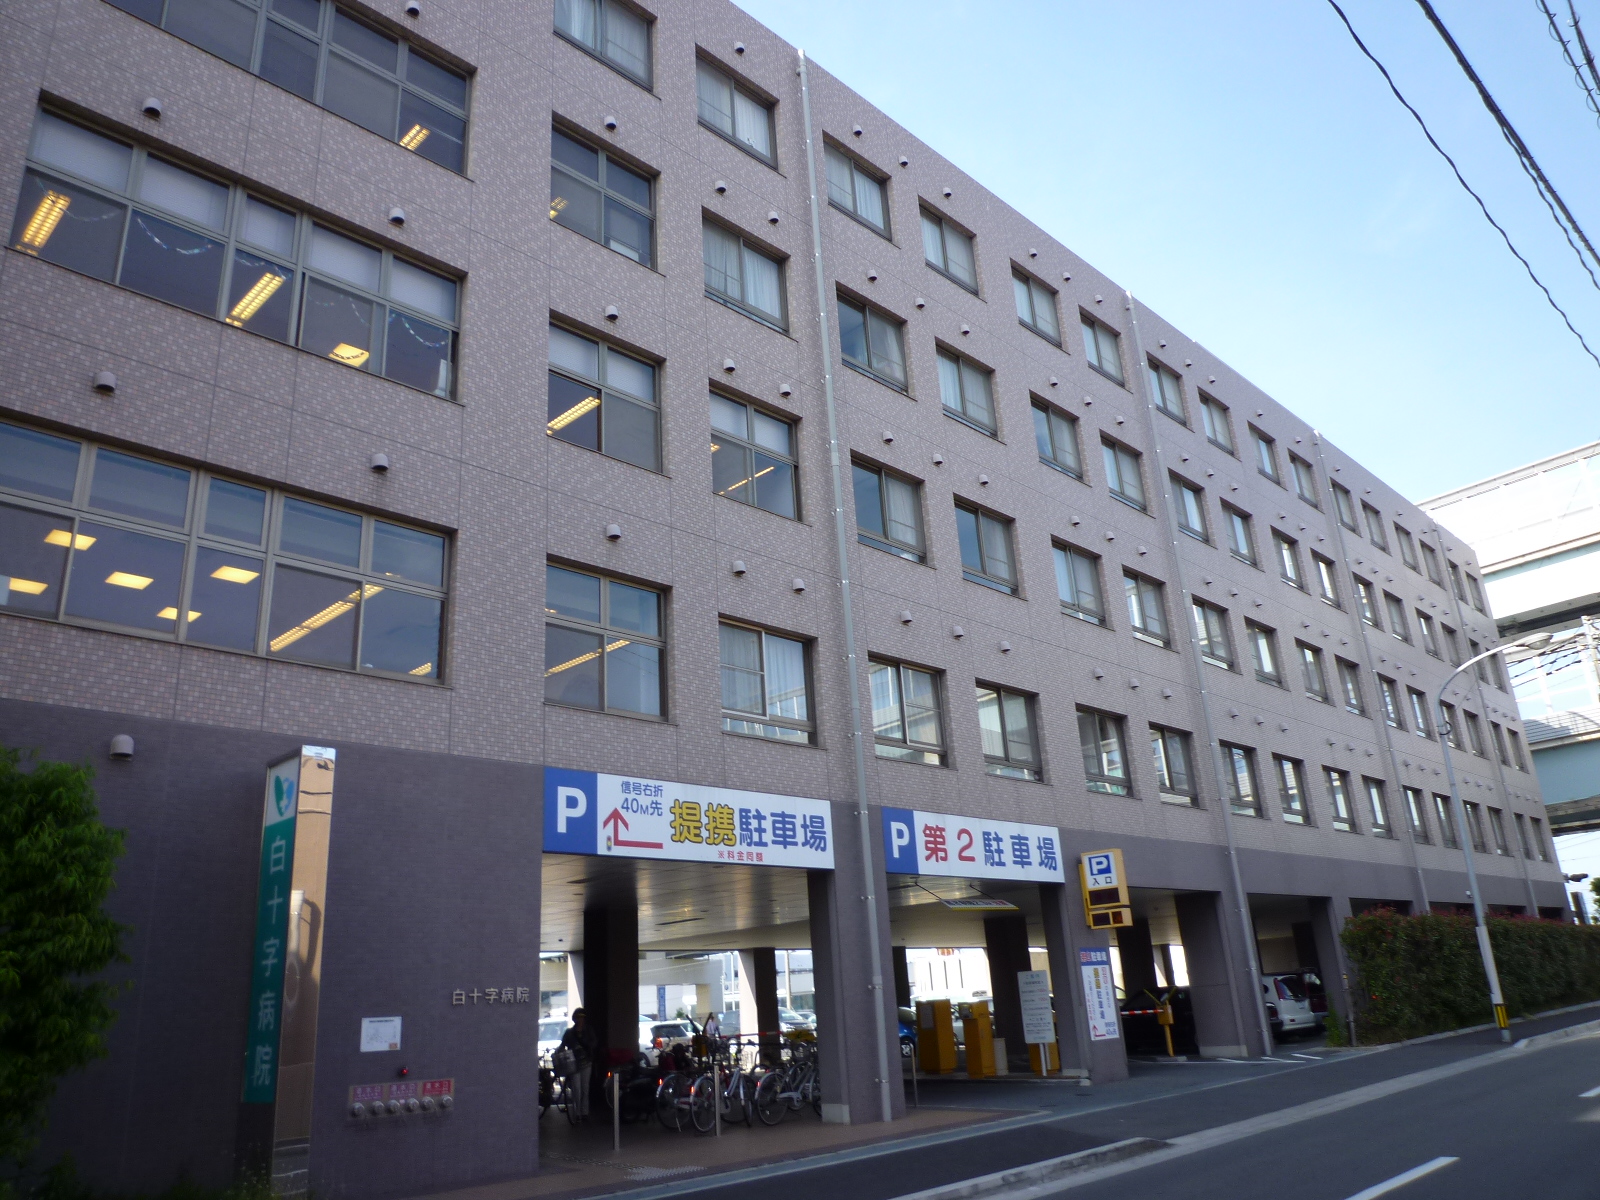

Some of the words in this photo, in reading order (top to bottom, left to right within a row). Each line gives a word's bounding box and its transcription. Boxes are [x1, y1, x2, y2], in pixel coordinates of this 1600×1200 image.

[620, 780, 664, 798] 信号右折
[557, 786, 588, 834] P
[670, 799, 827, 852] 提携駐車場
[890, 821, 910, 859] P
[922, 823, 1058, 871] 第2駐車場
[1090, 856, 1109, 875] P
[1092, 876, 1113, 886] 入口
[252, 835, 287, 1087] 白十字病院
[452, 986, 530, 1006] 白十字病院
